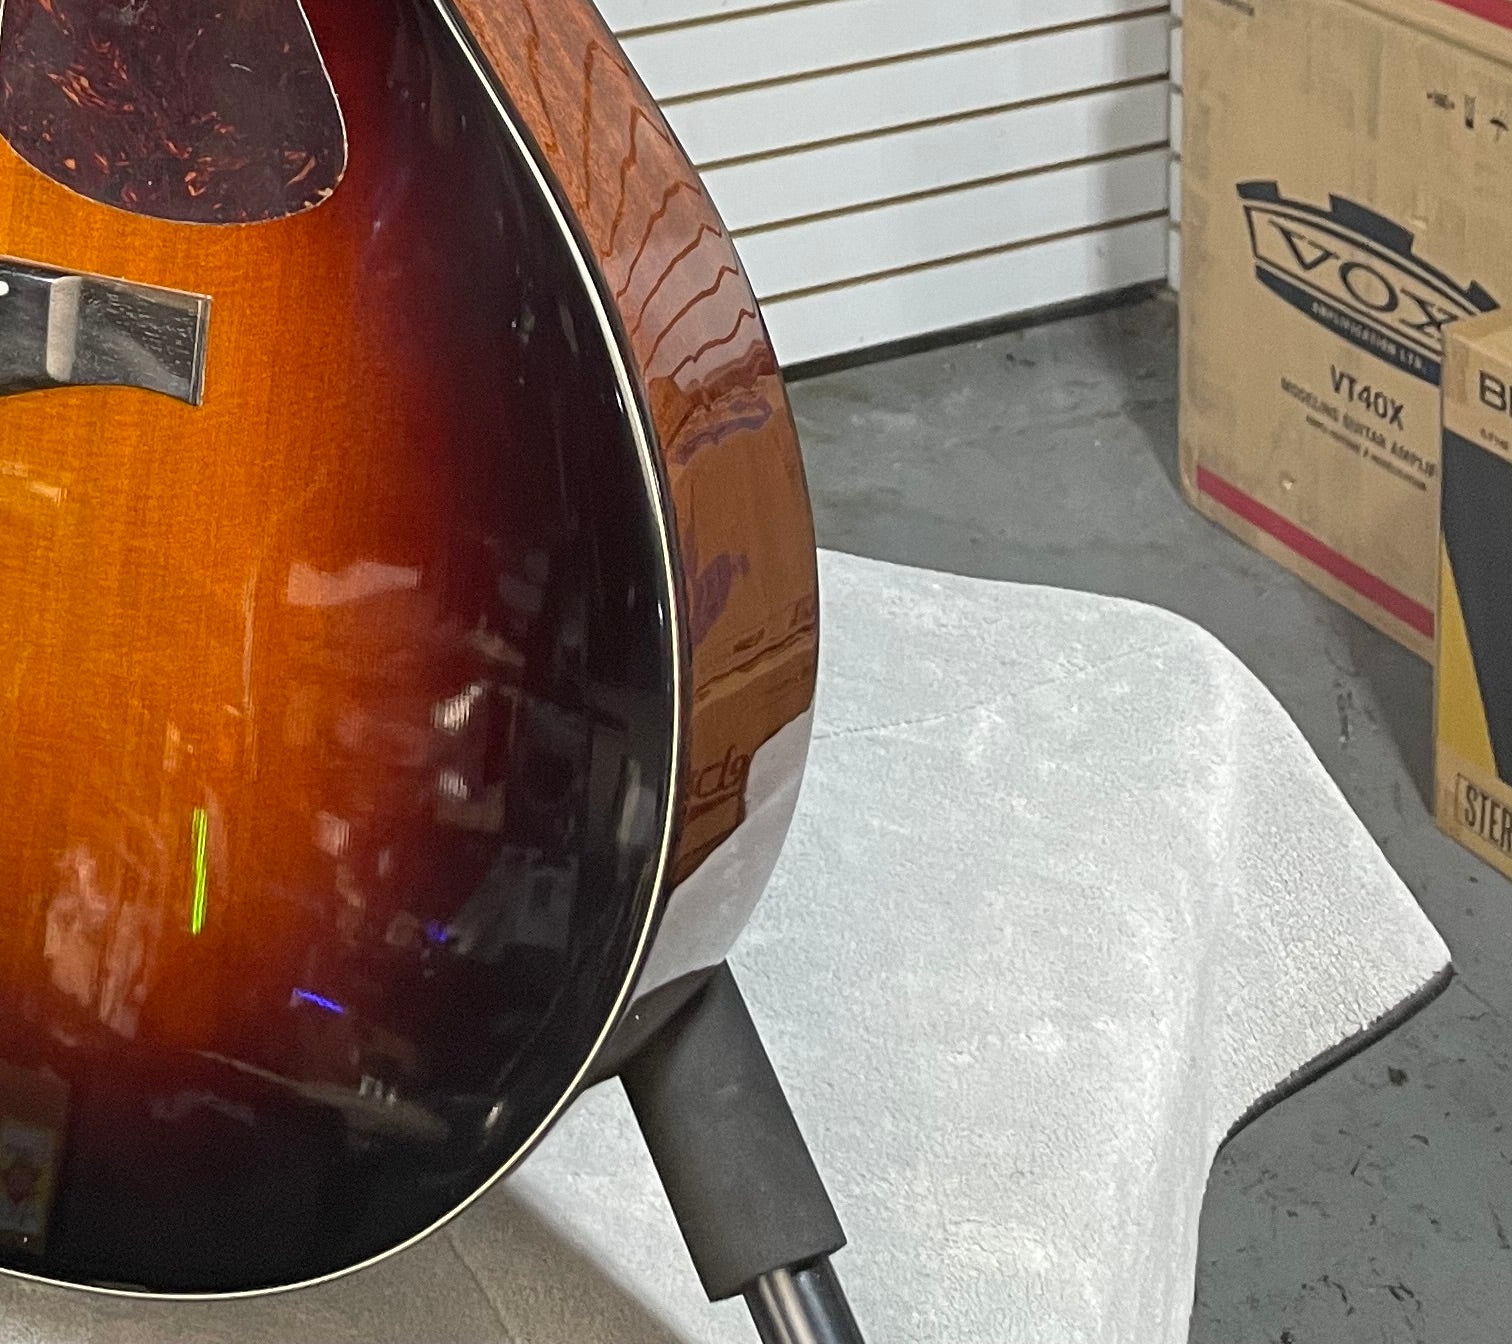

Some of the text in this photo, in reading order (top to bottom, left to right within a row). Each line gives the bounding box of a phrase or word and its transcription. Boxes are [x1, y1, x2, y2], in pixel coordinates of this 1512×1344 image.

[1268, 218, 1460, 341] VOX
[1330, 364, 1405, 431] VT40X
[1479, 369, 1512, 418] B
